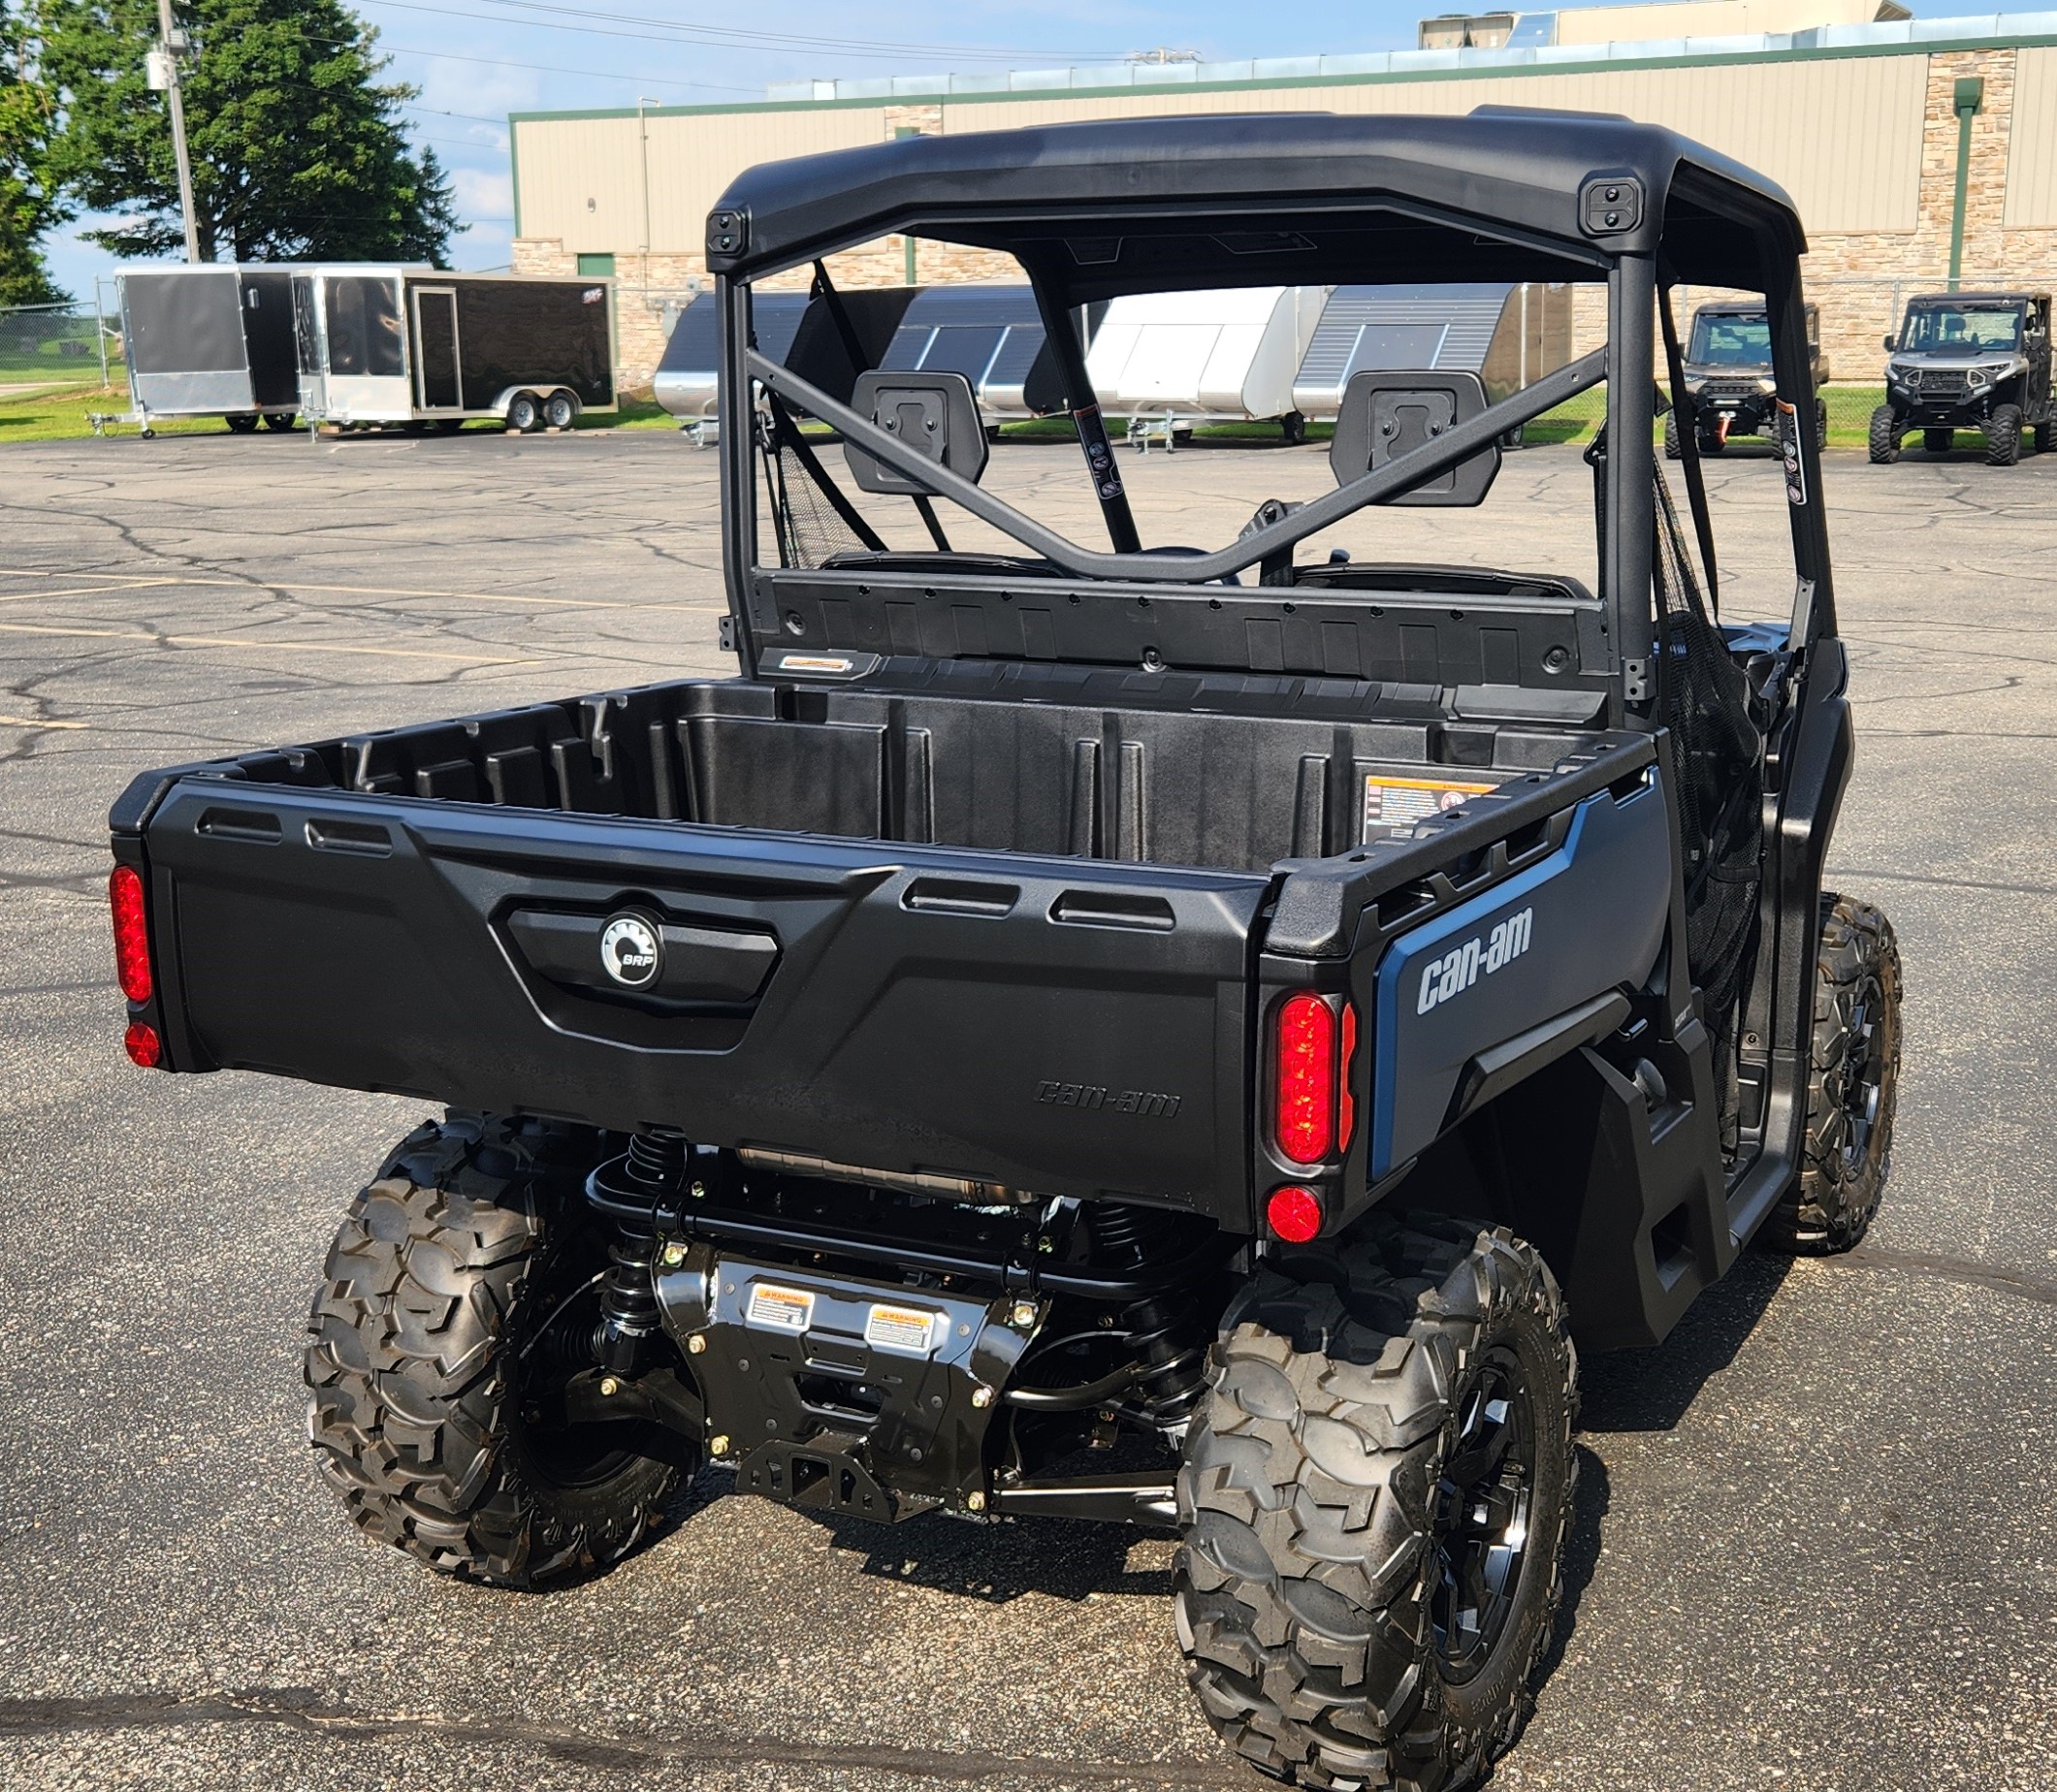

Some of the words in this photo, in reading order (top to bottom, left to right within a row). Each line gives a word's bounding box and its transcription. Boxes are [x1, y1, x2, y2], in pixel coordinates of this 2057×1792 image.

[623, 953, 655, 967] BRP
[771, 1292, 803, 1302] WARNING
[888, 1313, 921, 1324] WARNING
